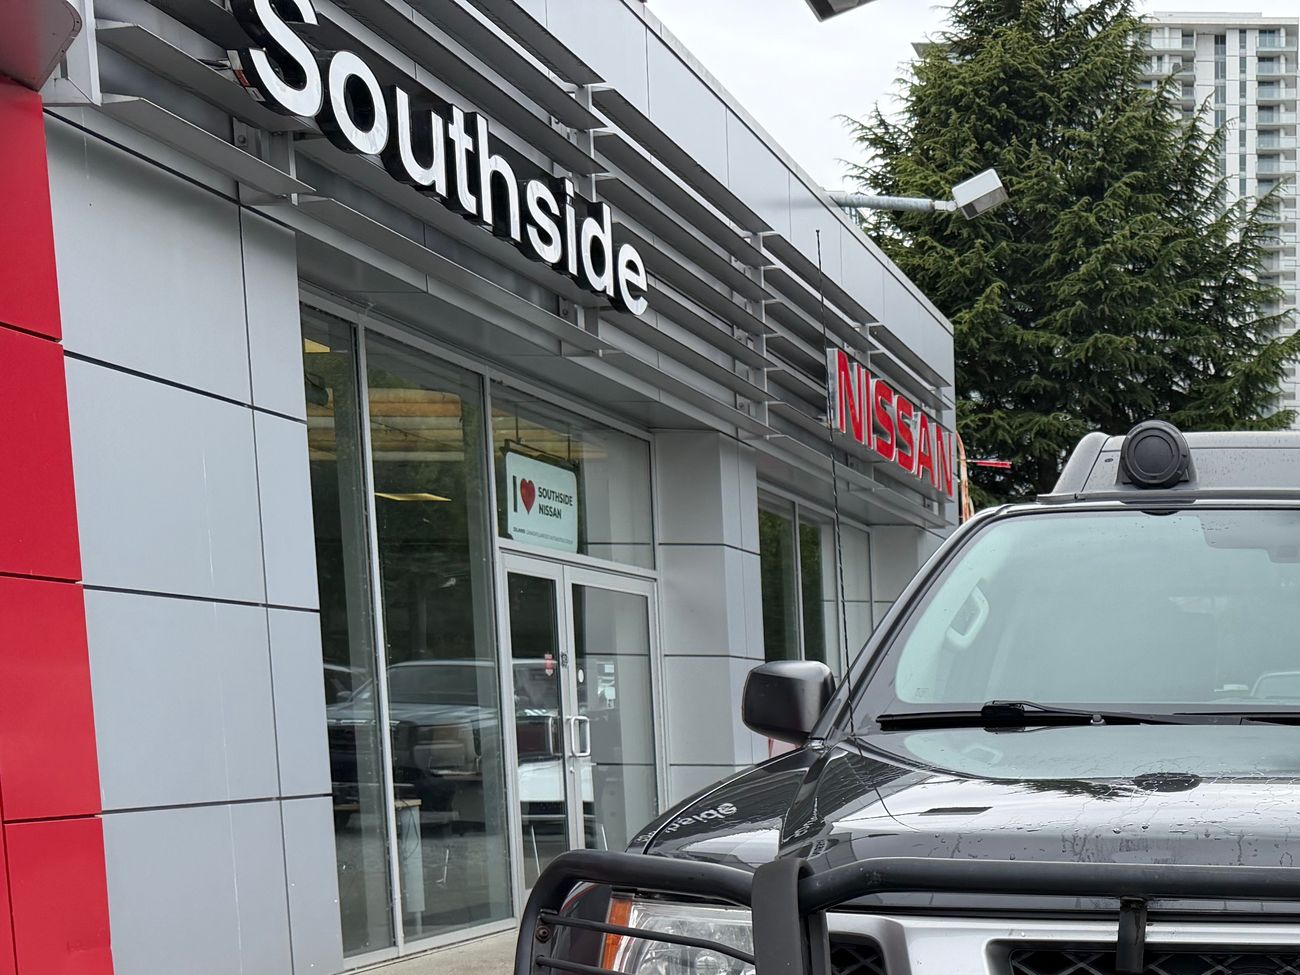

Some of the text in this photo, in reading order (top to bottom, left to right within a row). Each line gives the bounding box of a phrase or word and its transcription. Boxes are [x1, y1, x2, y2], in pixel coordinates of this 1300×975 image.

[249, 0, 649, 316] Southside
[836, 348, 953, 497] NISSAN
[513, 475, 518, 513] I
[538, 486, 573, 507] SOUTHSIDE
[538, 503, 562, 519] NISSAN
